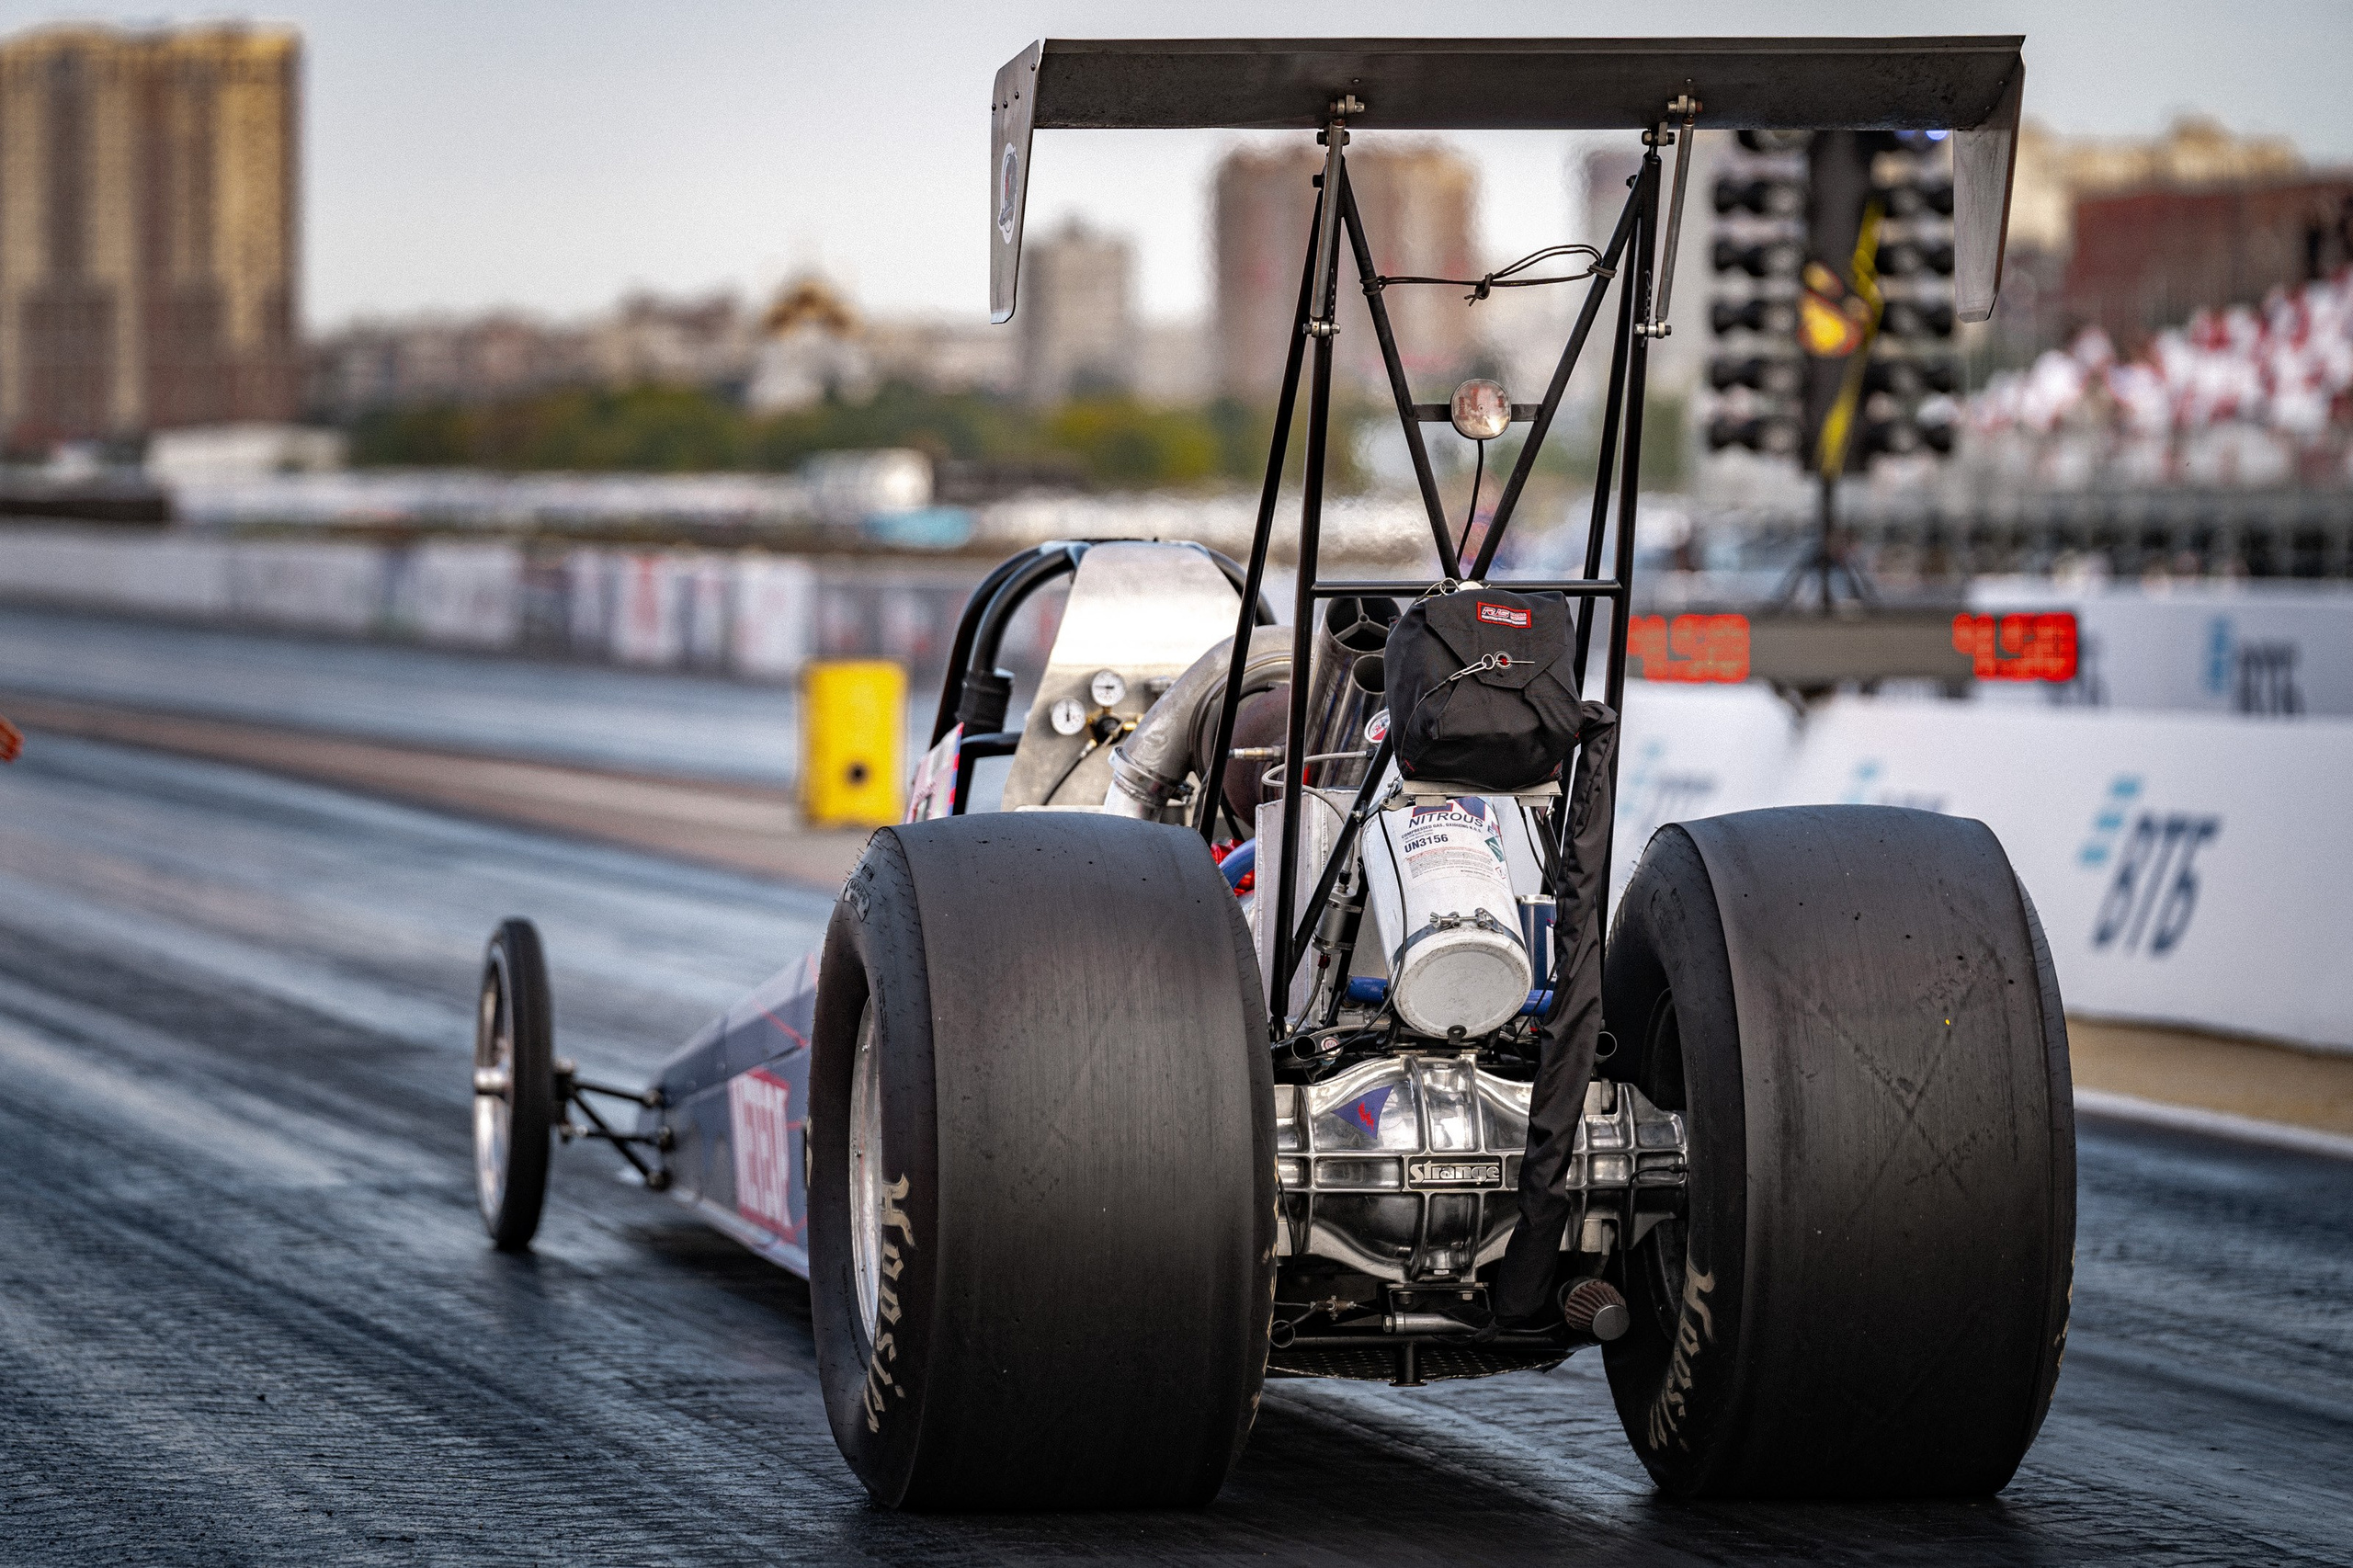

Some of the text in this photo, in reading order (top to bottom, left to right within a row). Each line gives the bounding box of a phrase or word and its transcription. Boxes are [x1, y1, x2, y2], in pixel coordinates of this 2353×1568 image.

[1408, 812, 1483, 828] NITROUS
[1401, 824, 1432, 839] COMPRESSED
[1404, 834, 1449, 853] UN3156
[1409, 1160, 1500, 1186] Strange
